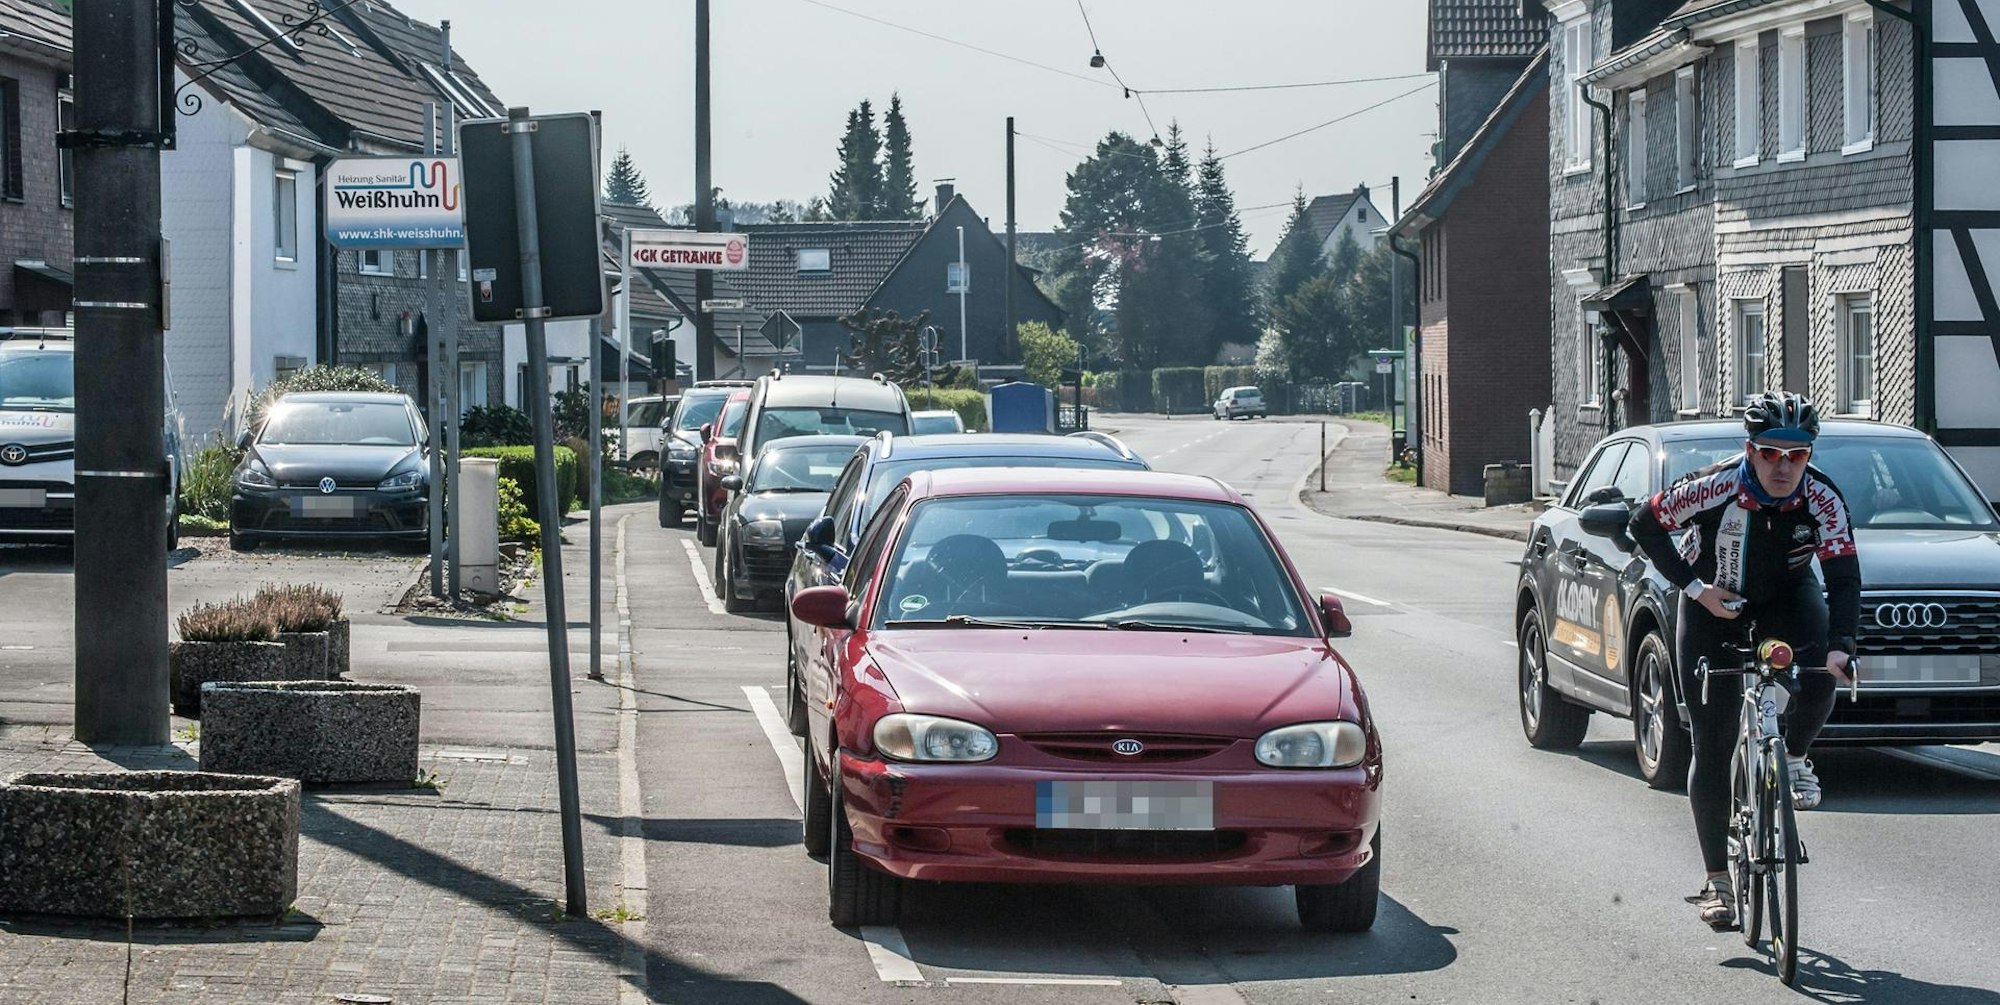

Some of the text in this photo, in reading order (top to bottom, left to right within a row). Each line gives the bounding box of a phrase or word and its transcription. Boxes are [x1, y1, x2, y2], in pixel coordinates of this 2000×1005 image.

[338, 174, 406, 184] Heizung Sanitär
[335, 190, 440, 209] Weißhuhn
[640, 249, 723, 265] GK GETRÄNKE
[1669, 479, 1734, 516] Hotelplan
[1729, 540, 1740, 578] BICYCLE
[1118, 742, 1139, 751] KIA
